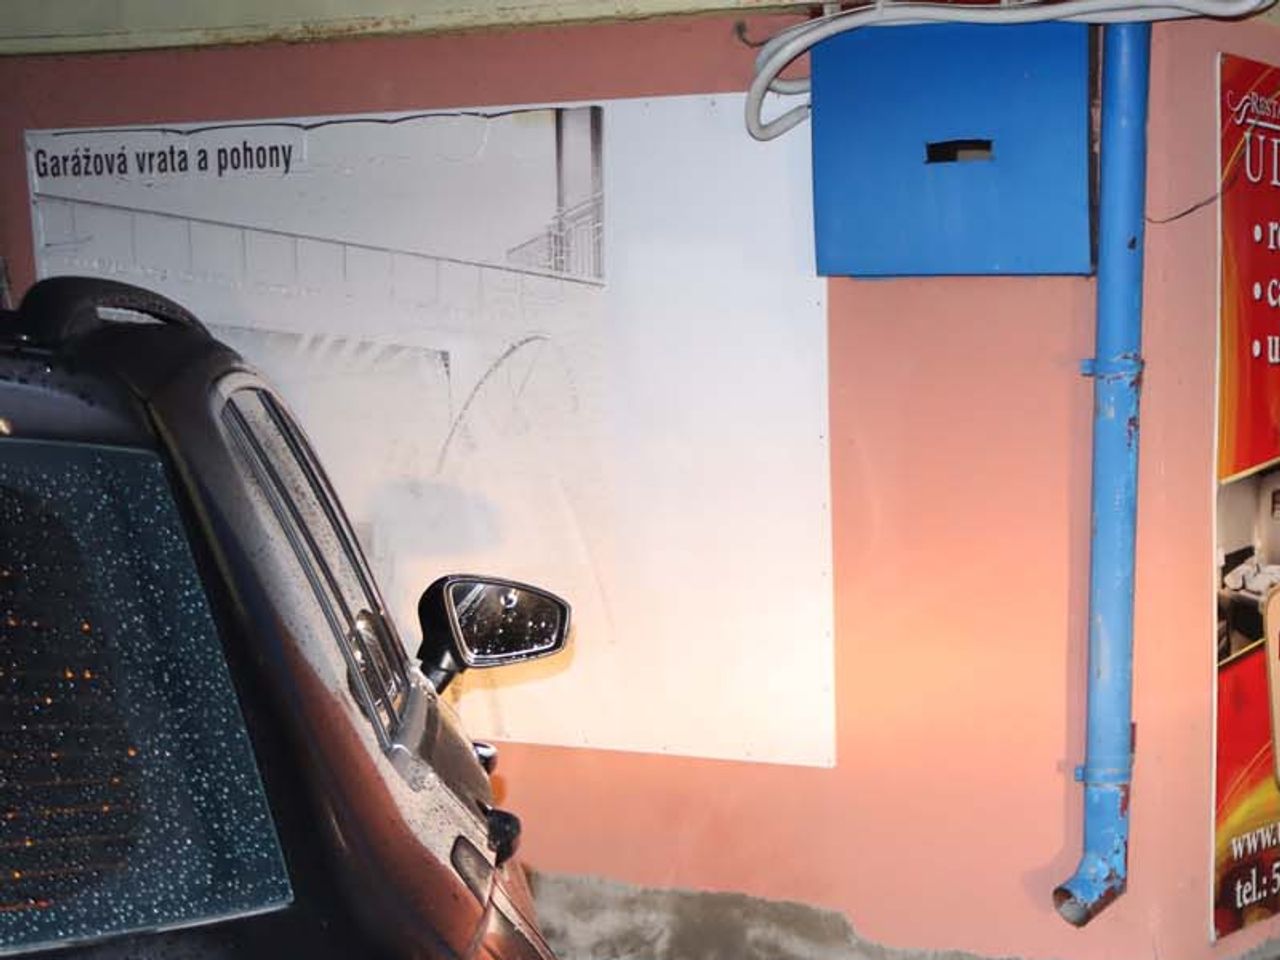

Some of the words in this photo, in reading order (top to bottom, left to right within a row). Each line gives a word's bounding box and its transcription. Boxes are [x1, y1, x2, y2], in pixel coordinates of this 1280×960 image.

[34, 146, 127, 178] Garážová
[136, 145, 188, 173] vrata
[198, 149, 208, 171] a
[218, 141, 292, 176] pohony
[1244, 132, 1266, 183] U
[1235, 868, 1267, 909] tel.:
